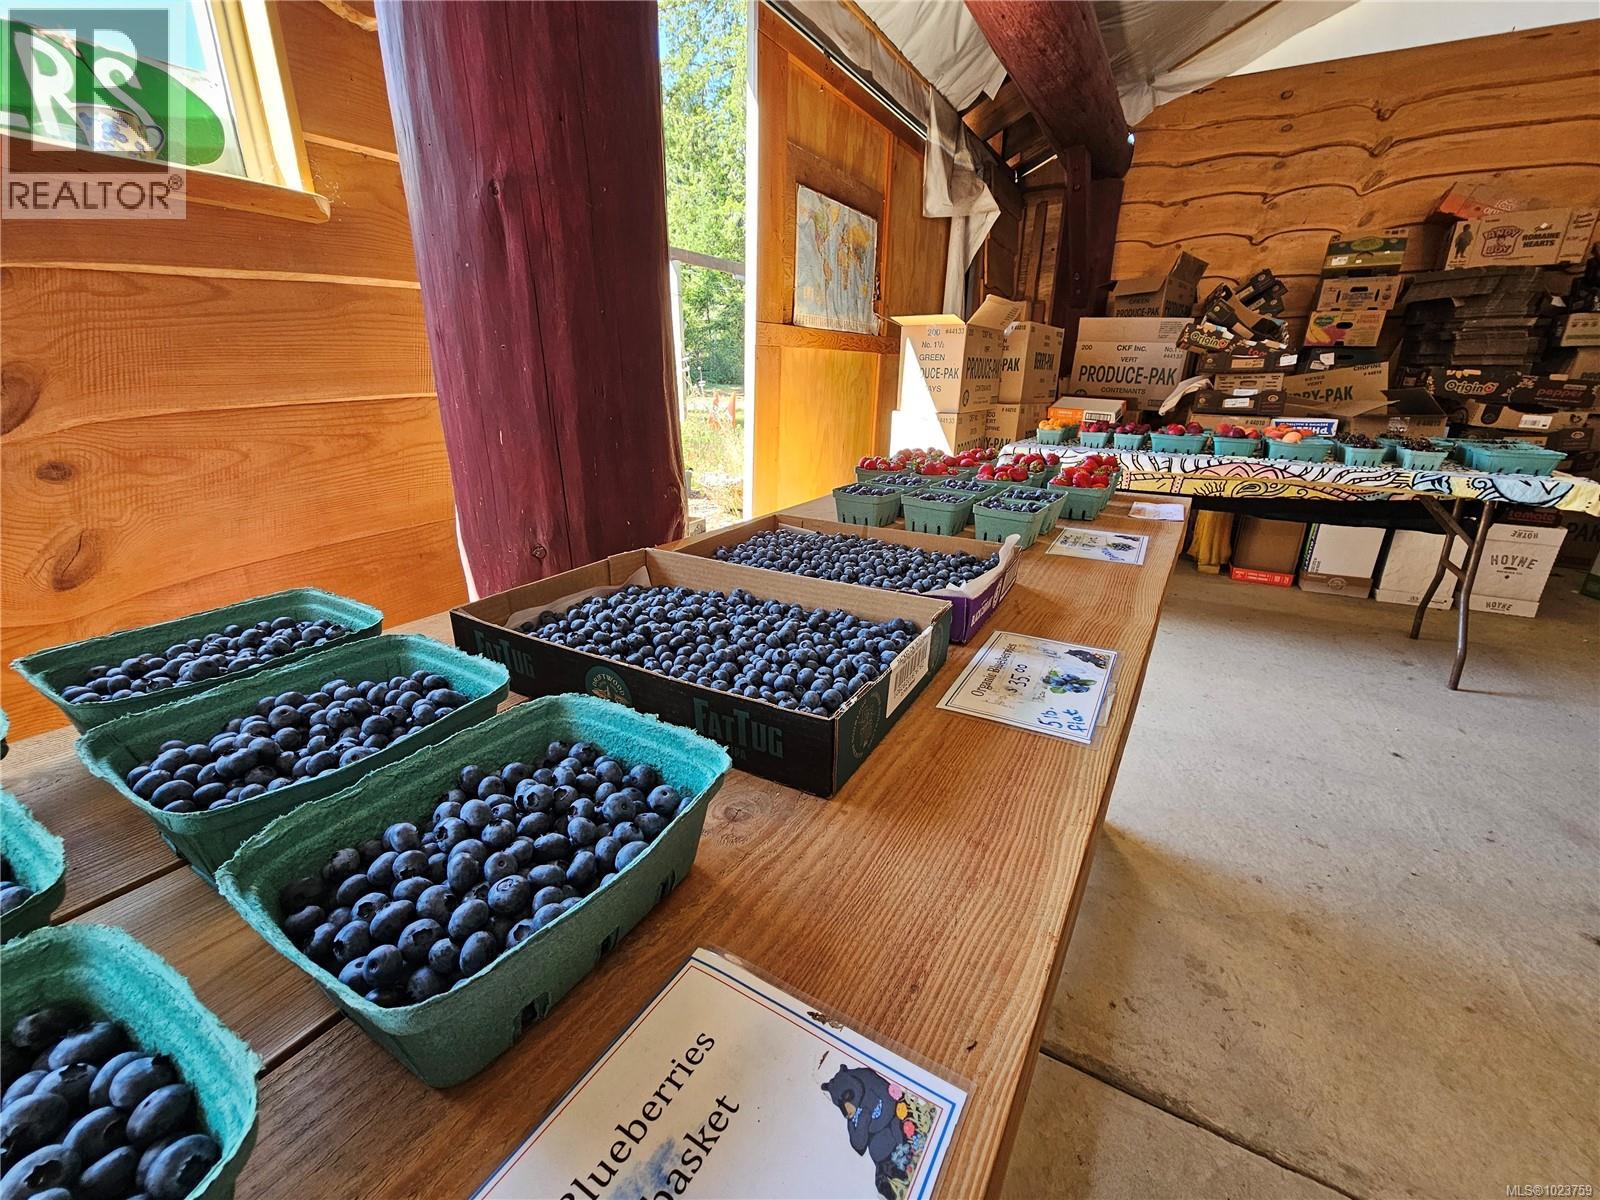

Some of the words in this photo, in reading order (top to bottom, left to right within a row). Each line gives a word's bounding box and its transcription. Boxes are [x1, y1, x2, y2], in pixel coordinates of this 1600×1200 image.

[1522, 232, 1561, 241] ROMAINE
[1522, 240, 1555, 248] HEARTS
[928, 328, 940, 336] 200
[1116, 344, 1132, 352] CKF
[919, 353, 946, 361] GREEN
[1078, 365, 1178, 386] PRODUCE-PAK
[1100, 386, 1146, 395] CONTENANTS
[1490, 554, 1539, 570] HOYNE
[1485, 600, 1513, 611] HOYNE
[971, 670, 997, 697] Organic
[987, 643, 1018, 674] Blueberries
